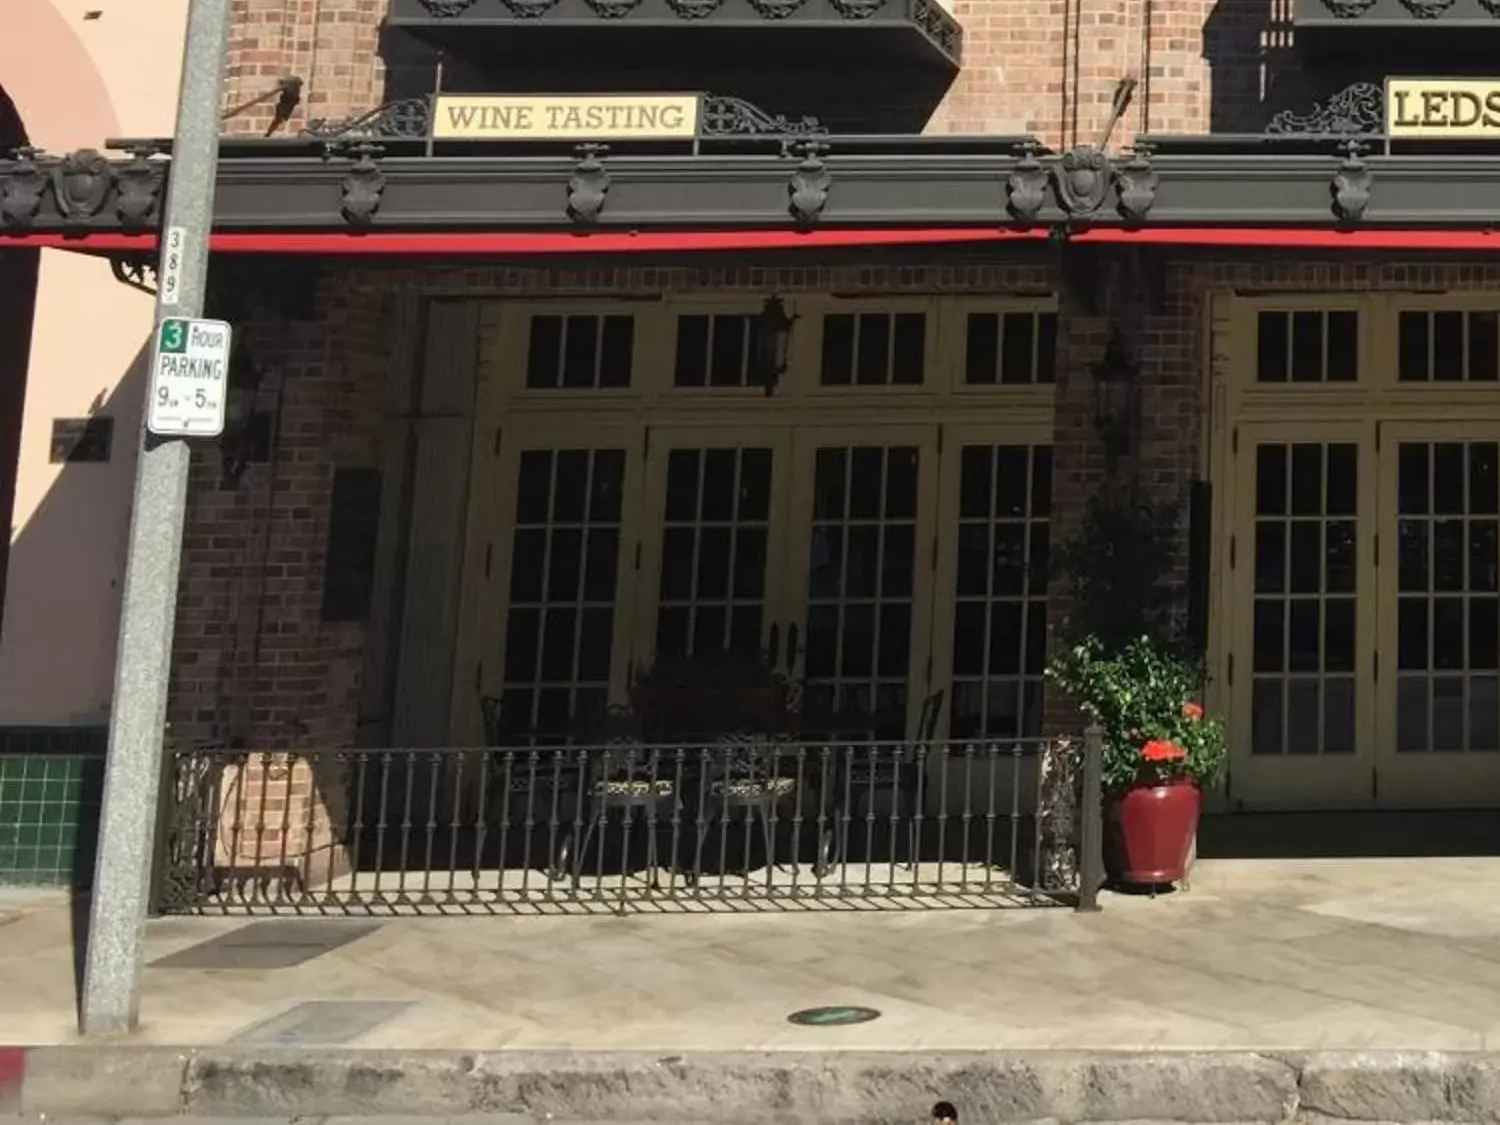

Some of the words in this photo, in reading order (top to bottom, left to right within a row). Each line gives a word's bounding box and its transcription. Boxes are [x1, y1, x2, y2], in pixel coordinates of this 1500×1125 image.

[447, 105, 534, 130] WINE
[545, 104, 686, 130] TASTING
[166, 230, 180, 293] 389
[164, 321, 183, 349] 3
[191, 331, 224, 348] HOUR
[159, 355, 223, 380] PARKING
